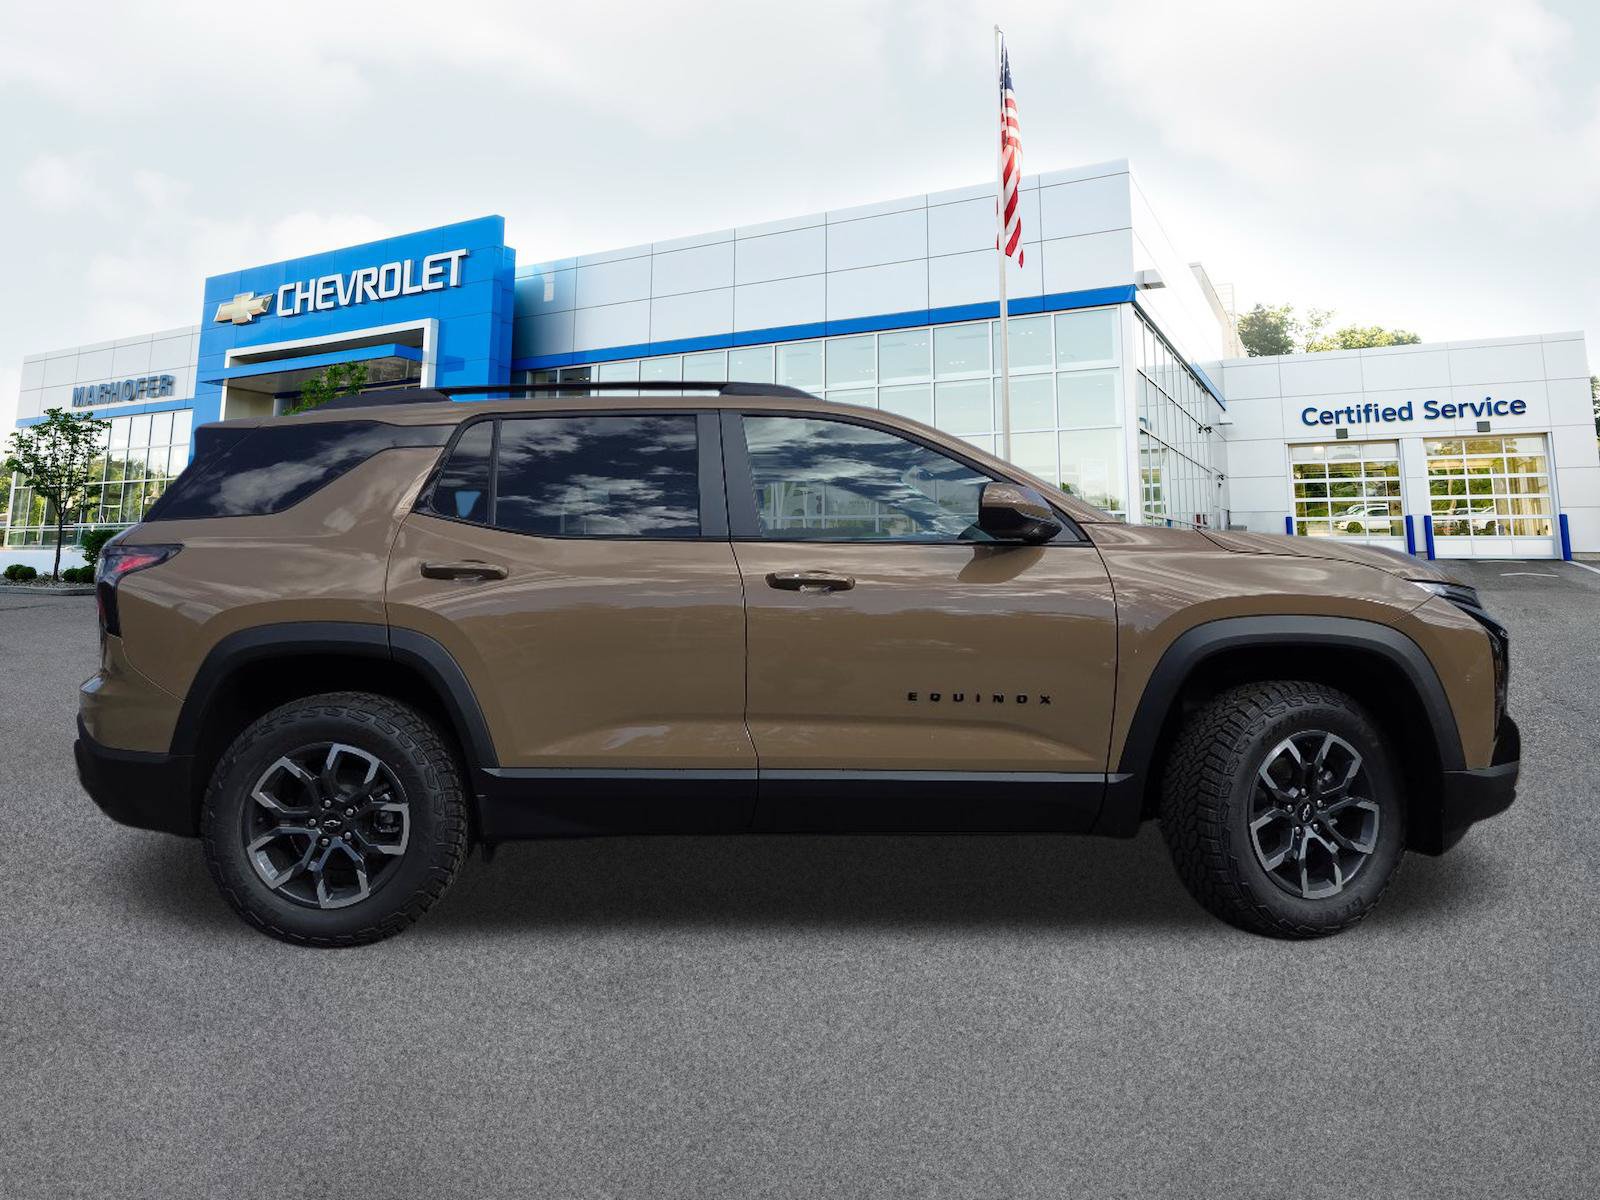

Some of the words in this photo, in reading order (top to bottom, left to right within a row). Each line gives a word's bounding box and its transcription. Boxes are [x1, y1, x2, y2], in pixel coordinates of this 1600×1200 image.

[275, 248, 468, 318] CHEVROLET
[72, 374, 175, 408] MARHOFER
[1301, 401, 1414, 426] Certified
[1423, 396, 1528, 420] Service
[907, 691, 1051, 705] EQUINOX
